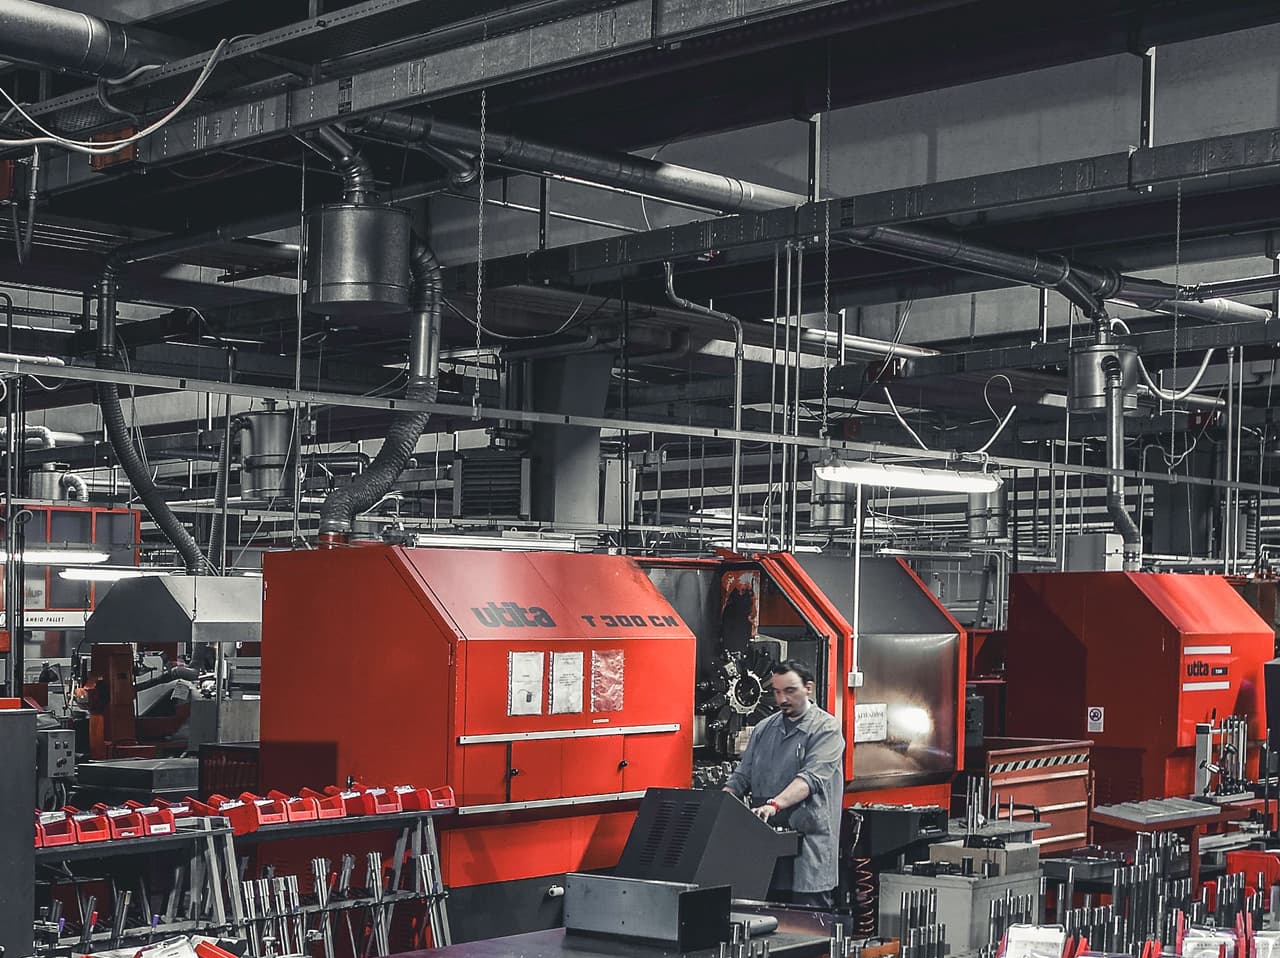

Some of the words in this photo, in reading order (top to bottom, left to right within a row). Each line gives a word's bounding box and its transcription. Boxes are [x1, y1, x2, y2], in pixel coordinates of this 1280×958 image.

[470, 602, 557, 628] utita
[581, 615, 596, 627] T
[599, 615, 648, 627] 300
[647, 615, 680, 627] CN
